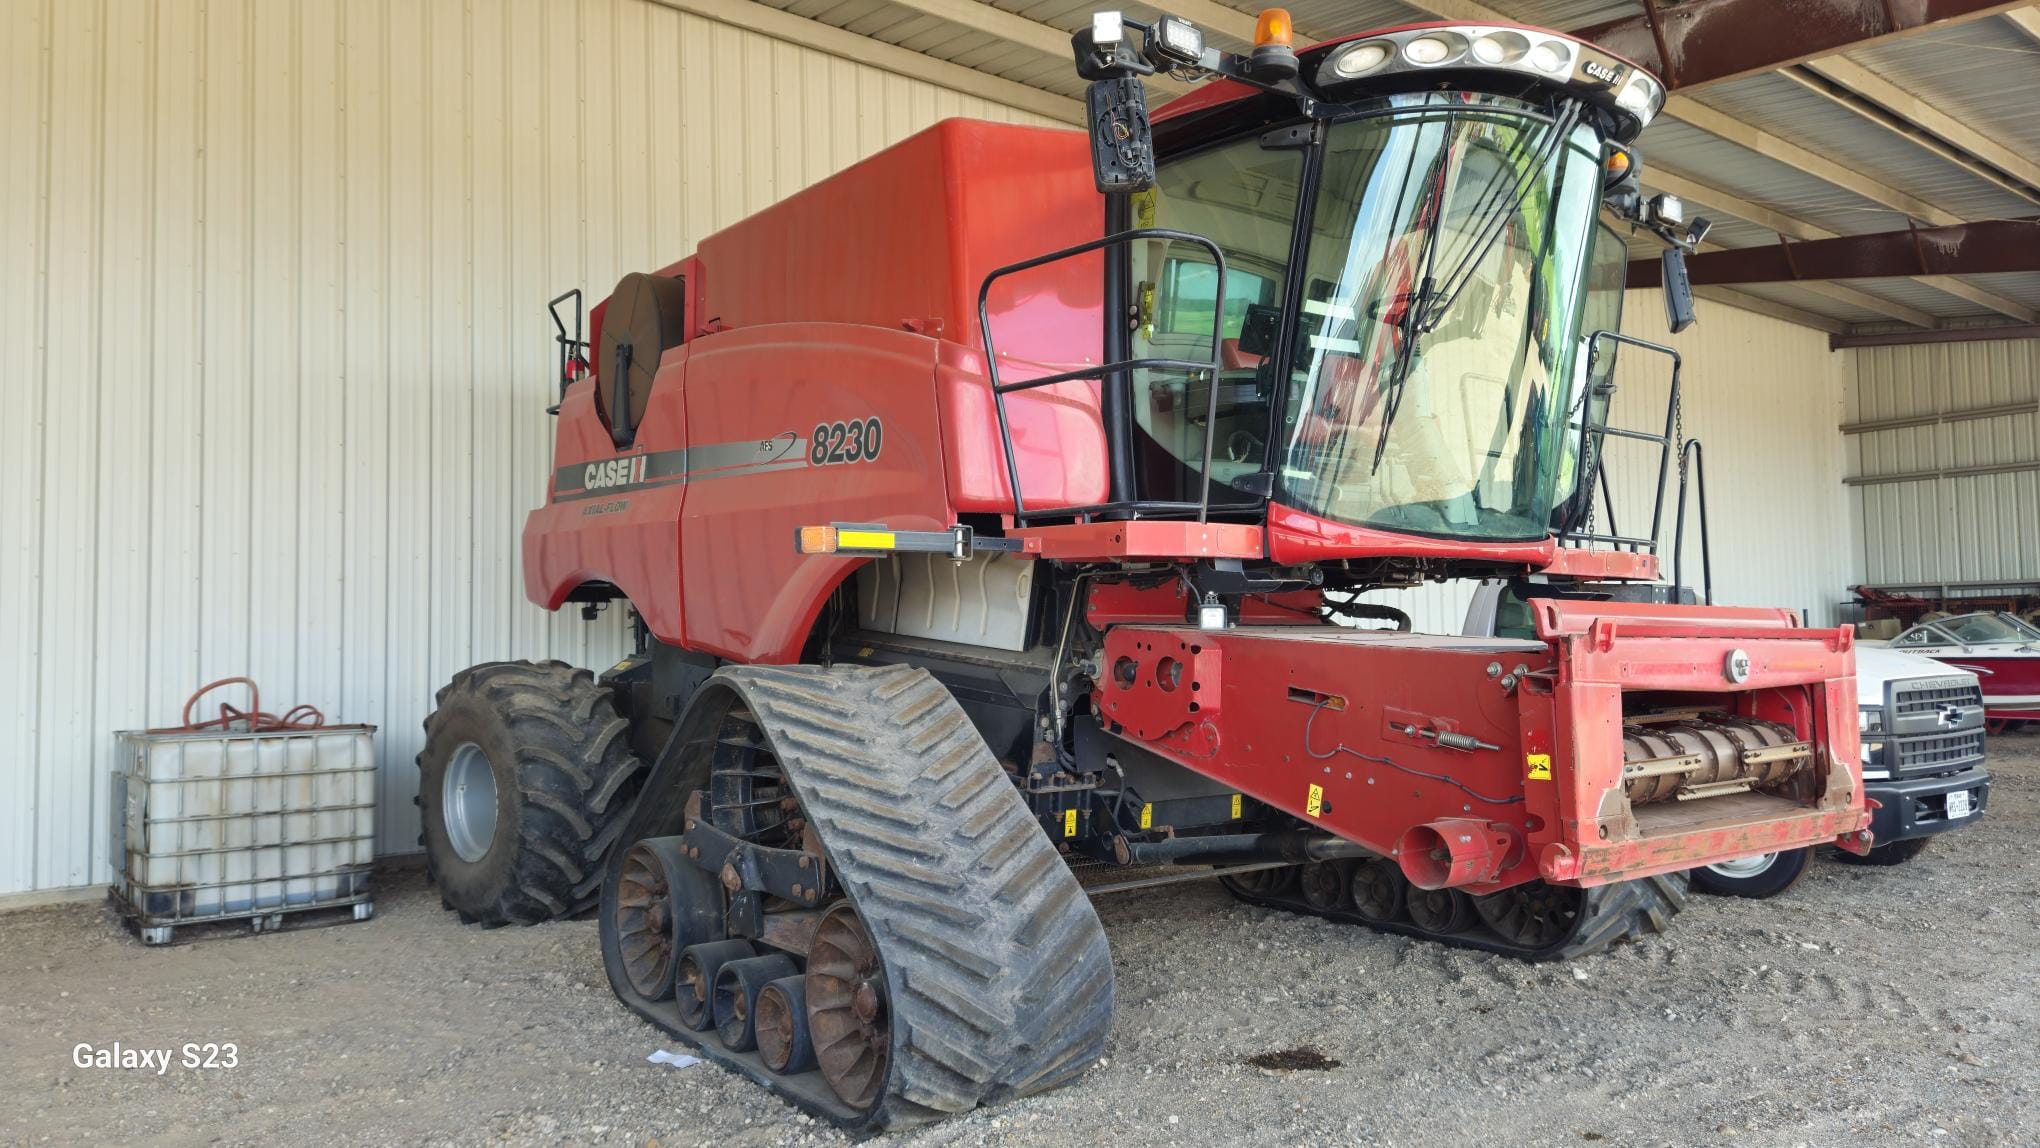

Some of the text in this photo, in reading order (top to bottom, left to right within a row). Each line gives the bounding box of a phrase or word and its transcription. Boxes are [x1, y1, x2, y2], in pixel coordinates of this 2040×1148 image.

[1586, 62, 1615, 82] CASE
[760, 440, 773, 452] AFS
[811, 416, 882, 466] 8230
[584, 459, 629, 490] CASE
[1911, 678, 1970, 690] CHEVROLET
